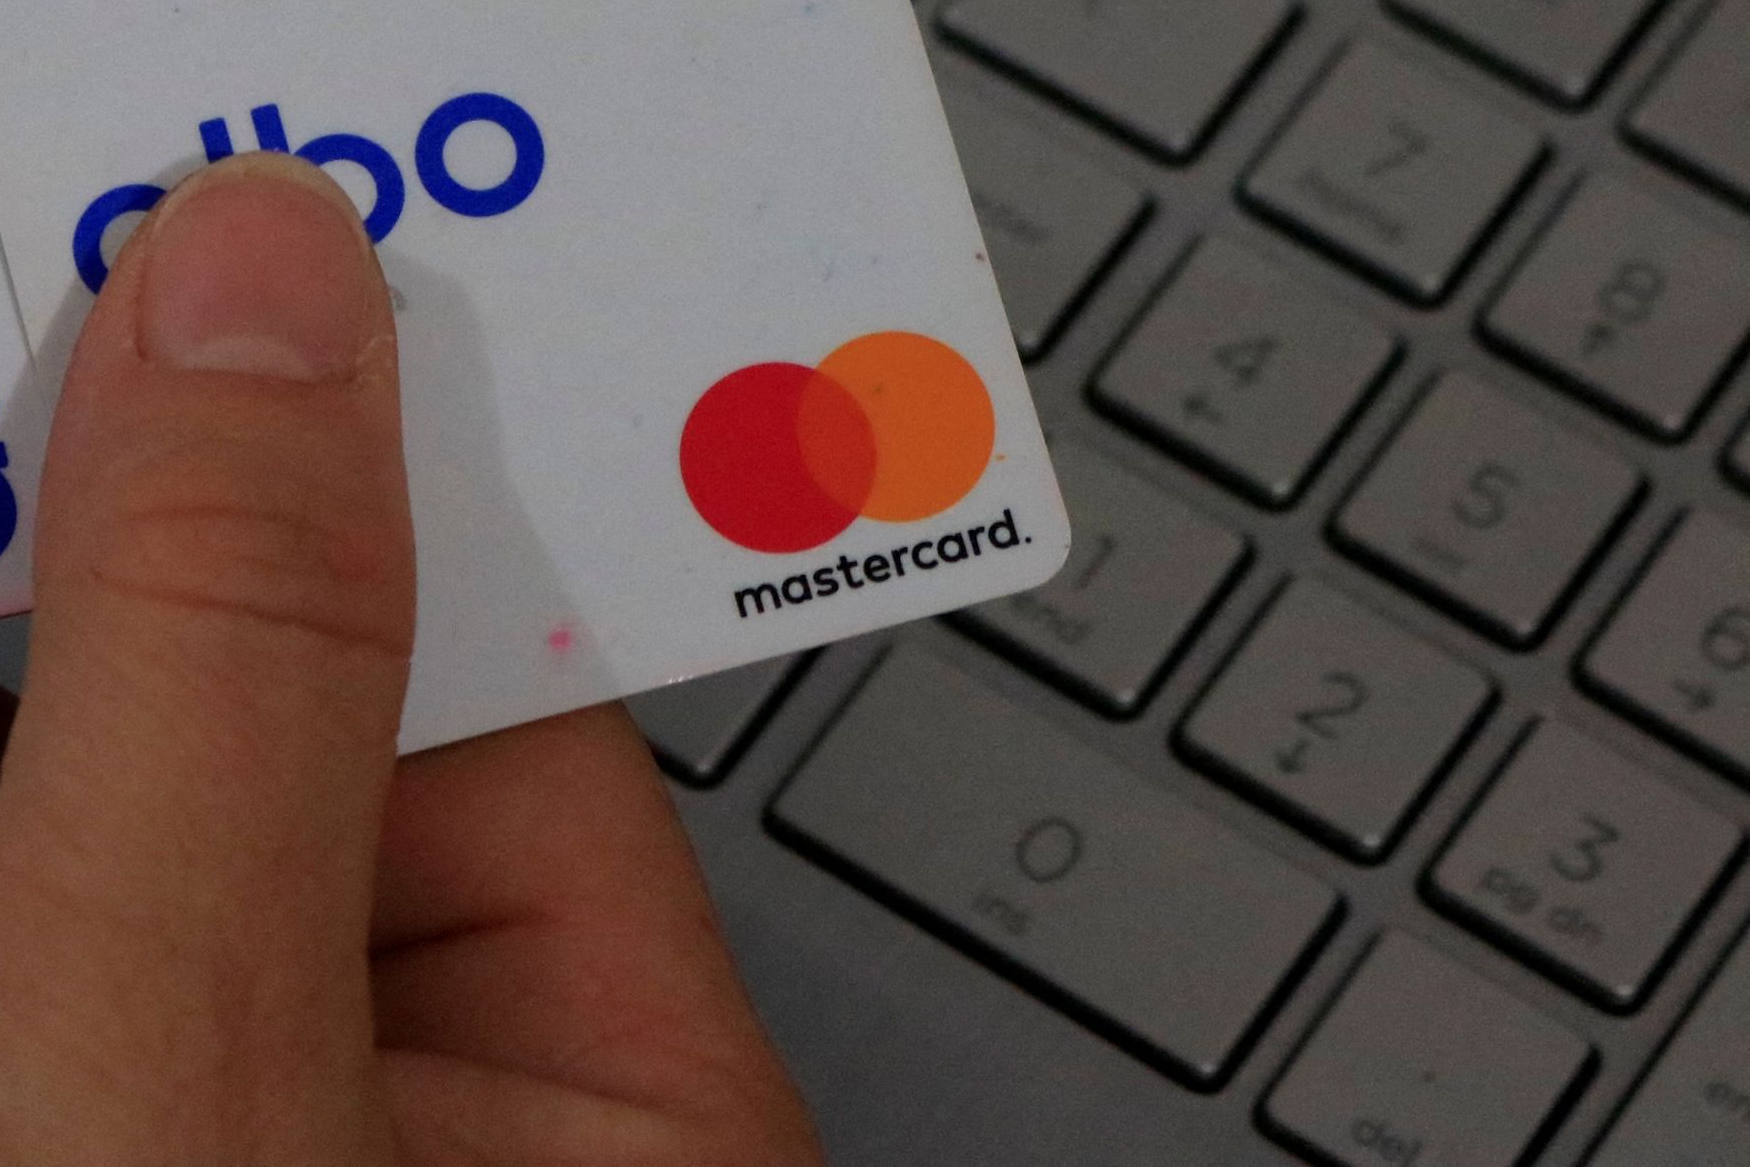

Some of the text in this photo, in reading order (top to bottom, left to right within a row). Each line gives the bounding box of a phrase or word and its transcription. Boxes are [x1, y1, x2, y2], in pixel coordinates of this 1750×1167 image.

[1365, 118, 1428, 177] 7
[1596, 259, 1666, 324] 8
[1214, 333, 1279, 386] 4
[1451, 461, 1519, 530] 5
[732, 507, 1033, 619] mastercard.
[1699, 606, 1750, 671] 6
[1294, 670, 1371, 739] 2
[1550, 814, 1620, 882] 3
[1477, 866, 1539, 916] pg
[1351, 1117, 1425, 1165] del
